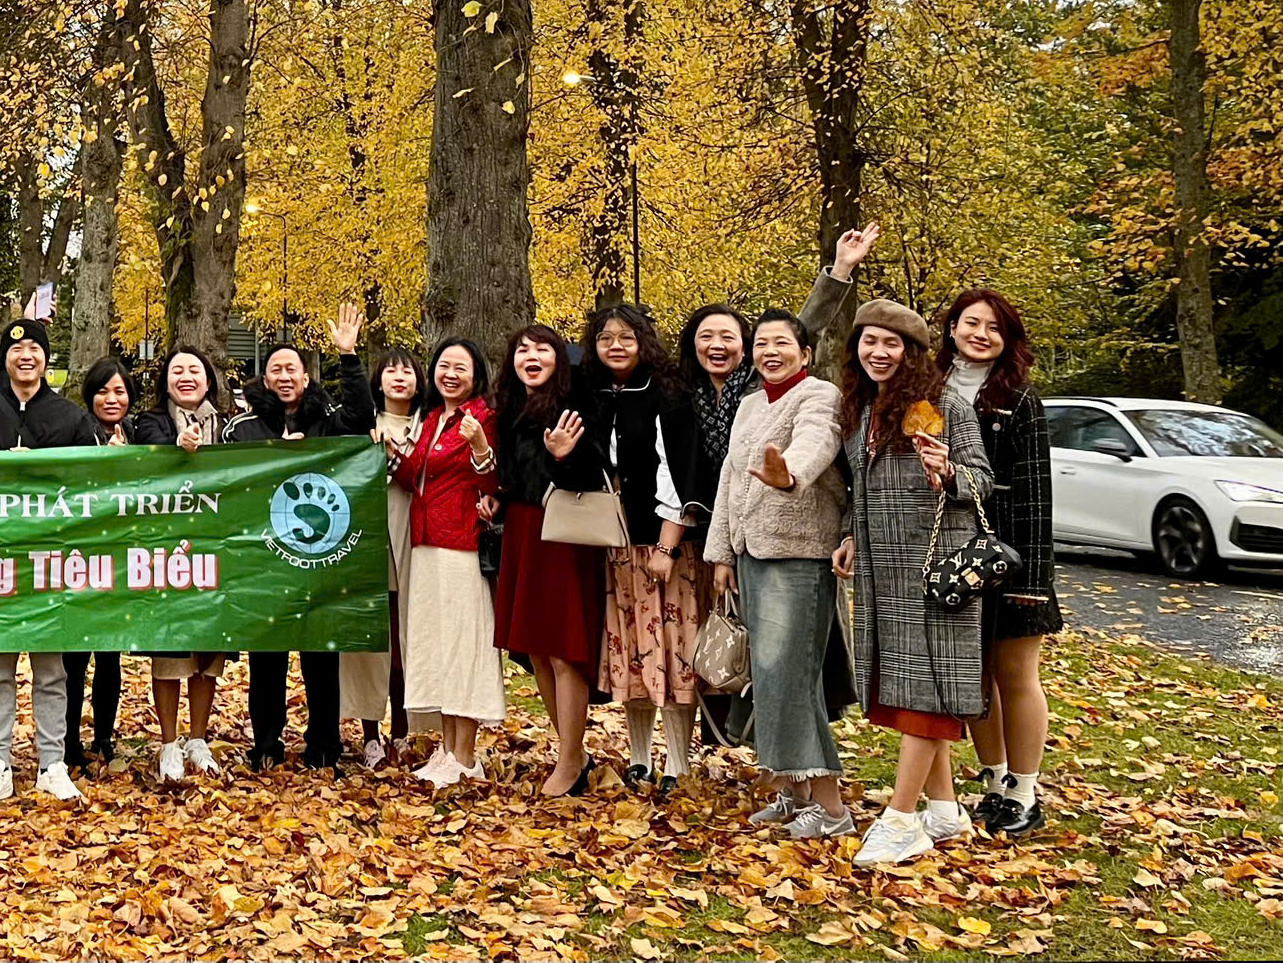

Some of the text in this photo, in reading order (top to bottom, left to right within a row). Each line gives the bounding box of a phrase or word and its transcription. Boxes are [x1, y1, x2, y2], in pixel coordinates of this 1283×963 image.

[109, 480, 222, 516] TRIỂN
[28, 548, 114, 590] Tiêu
[127, 538, 219, 590] Biểu
